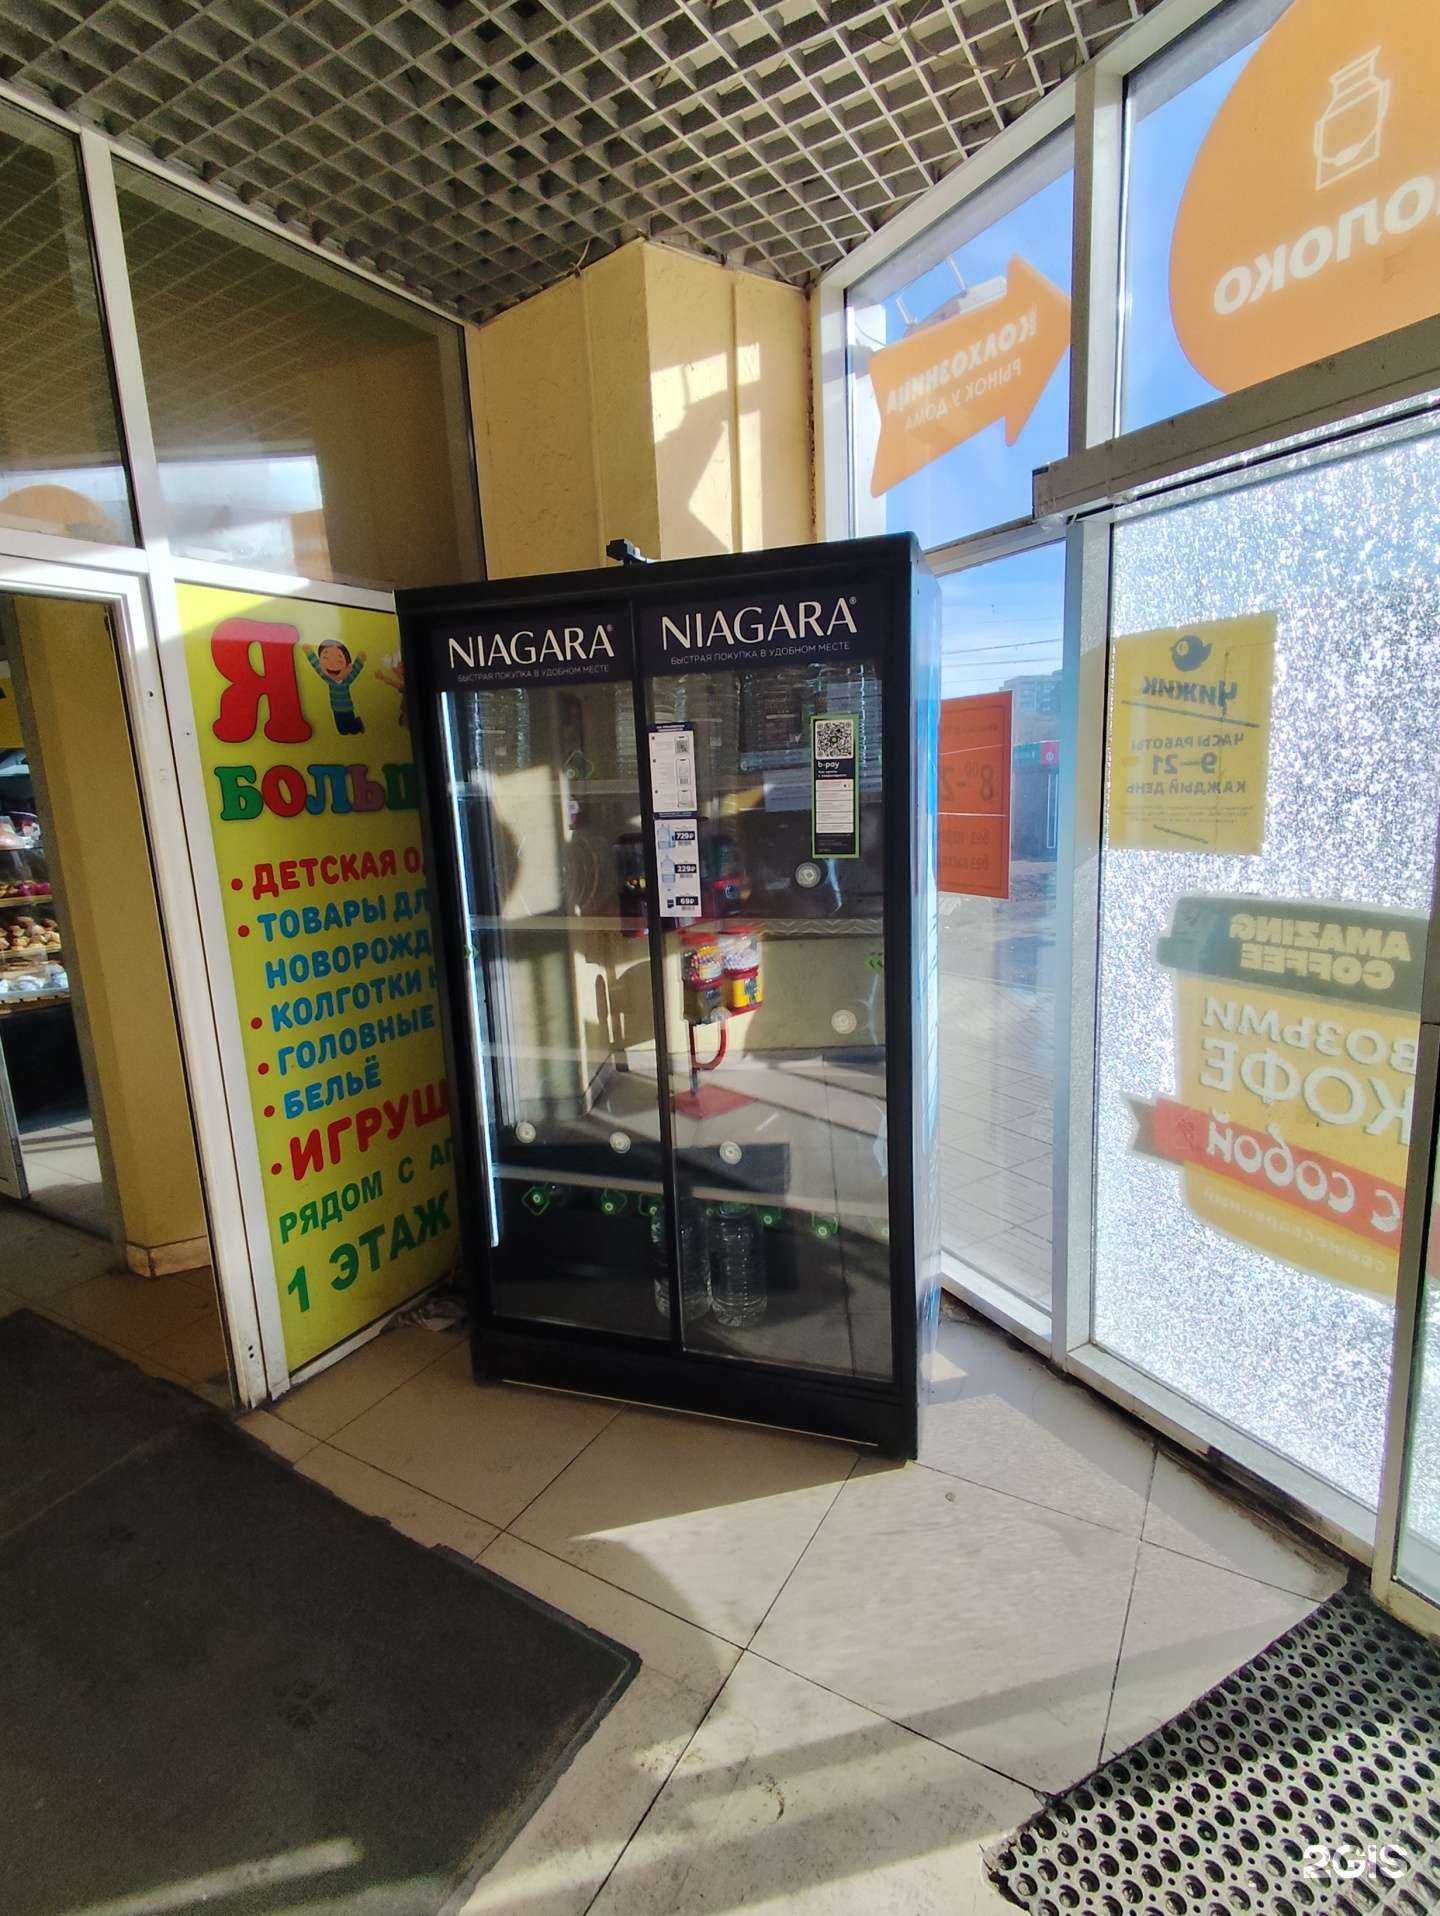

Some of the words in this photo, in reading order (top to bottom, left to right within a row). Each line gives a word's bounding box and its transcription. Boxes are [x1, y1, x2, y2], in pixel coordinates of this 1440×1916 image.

[448, 625, 615, 669] NIAGARA
[661, 597, 858, 650] NIAGARA
[671, 655, 712, 665] БЫСТРАЯ
[713, 651, 758, 661] ПОКУПКА
[760, 649, 766, 657] В
[769, 645, 816, 657] УДОБНОМ
[818, 642, 849, 652] МЕСТЕ
[211, 616, 313, 745] Я
[494, 671, 532, 681] ПОКУПКА
[542, 667, 581, 677] УДОБНОМ
[583, 665, 609, 673] МЕСТЕ
[252, 848, 398, 901] ДЕТСКАЯ
[256, 894, 387, 942] ТОВАРЫ
[264, 928, 432, 990] НОВОРОЖД
[271, 968, 422, 1033] КОЛГОТКИ
[277, 1003, 435, 1077] ГОЛОВНЫЕ
[283, 1055, 382, 1120] БЕЛЬЁ
[278, 1169, 384, 1245] РЯДОМ
[287, 1265, 311, 1313] 1
[328, 1190, 451, 1292] ЭТАЖ
